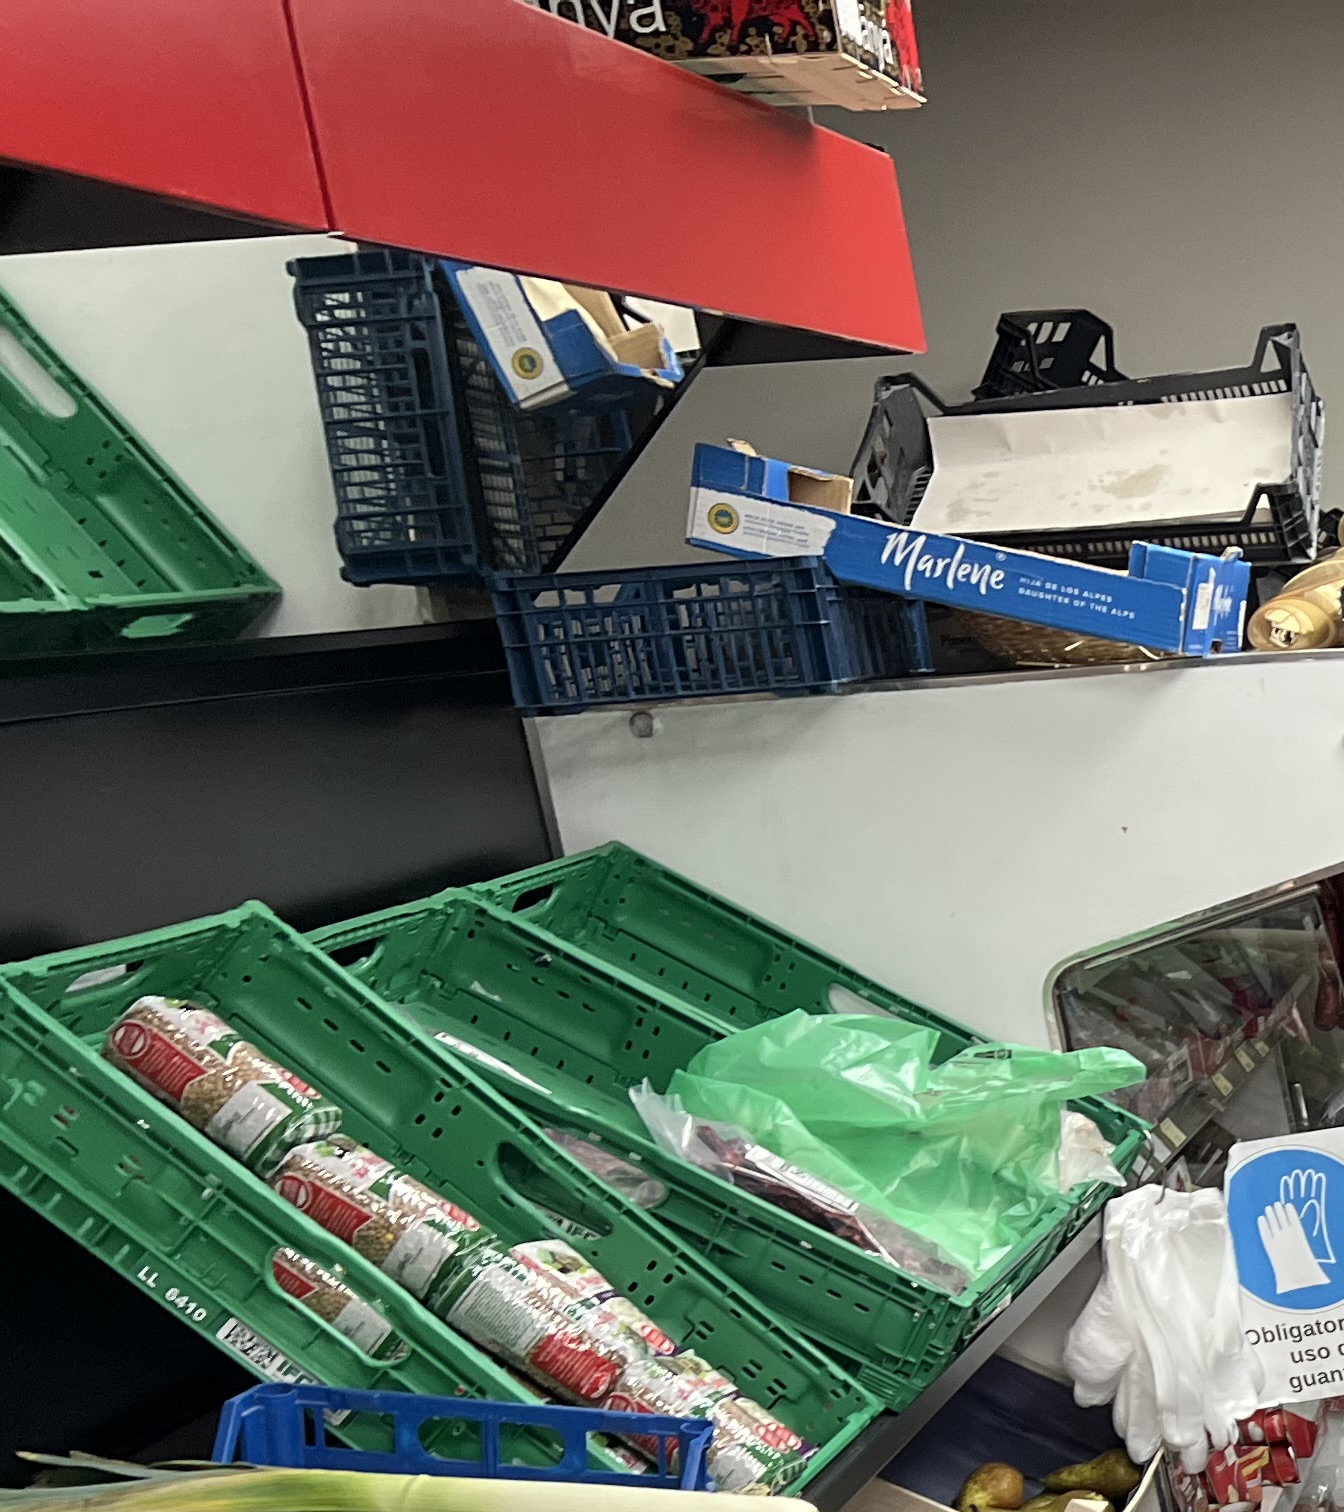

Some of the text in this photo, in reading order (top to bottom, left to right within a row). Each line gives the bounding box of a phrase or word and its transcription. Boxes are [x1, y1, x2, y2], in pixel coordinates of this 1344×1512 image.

[880, 531, 1006, 596] Marlene
[1018, 587, 1070, 605] DAUGHTER
[1089, 603, 1108, 613] THE
[1110, 608, 1135, 620] ALPS
[1290, 1344, 1330, 1364] uso
